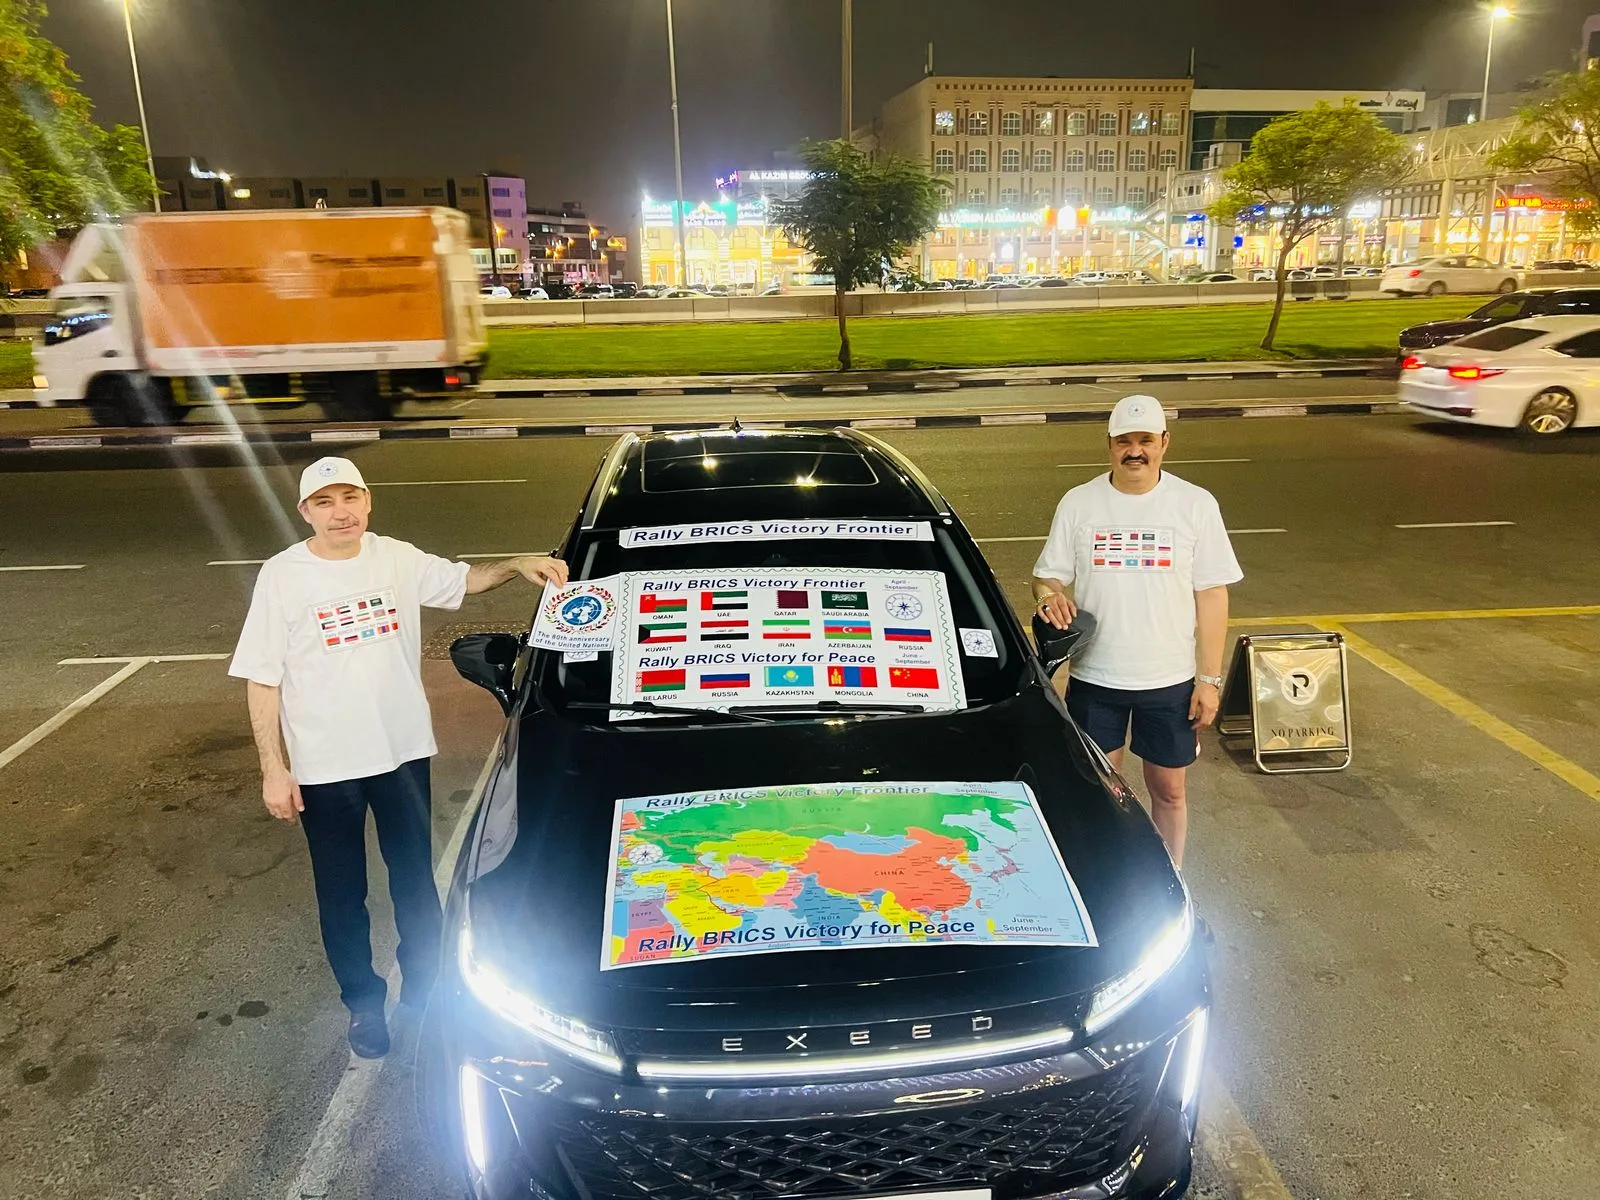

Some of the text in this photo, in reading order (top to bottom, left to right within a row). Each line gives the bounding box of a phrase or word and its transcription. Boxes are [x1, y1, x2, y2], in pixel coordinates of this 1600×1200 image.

[633, 523, 913, 542] Rally BRICS Victory Frontier
[643, 578, 865, 592] Rally BRICS Victory Frontier
[537, 630, 550, 638] The
[639, 652, 875, 668] Rally BRICS Victory for Peace
[1271, 727, 1334, 738] NO PARKING
[646, 785, 928, 808] Rally BRICS Victory Frontier
[639, 921, 975, 952] Rally BRICS Victory for Peace
[1003, 924, 1053, 933] September
[722, 1016, 993, 1051] EXEED
